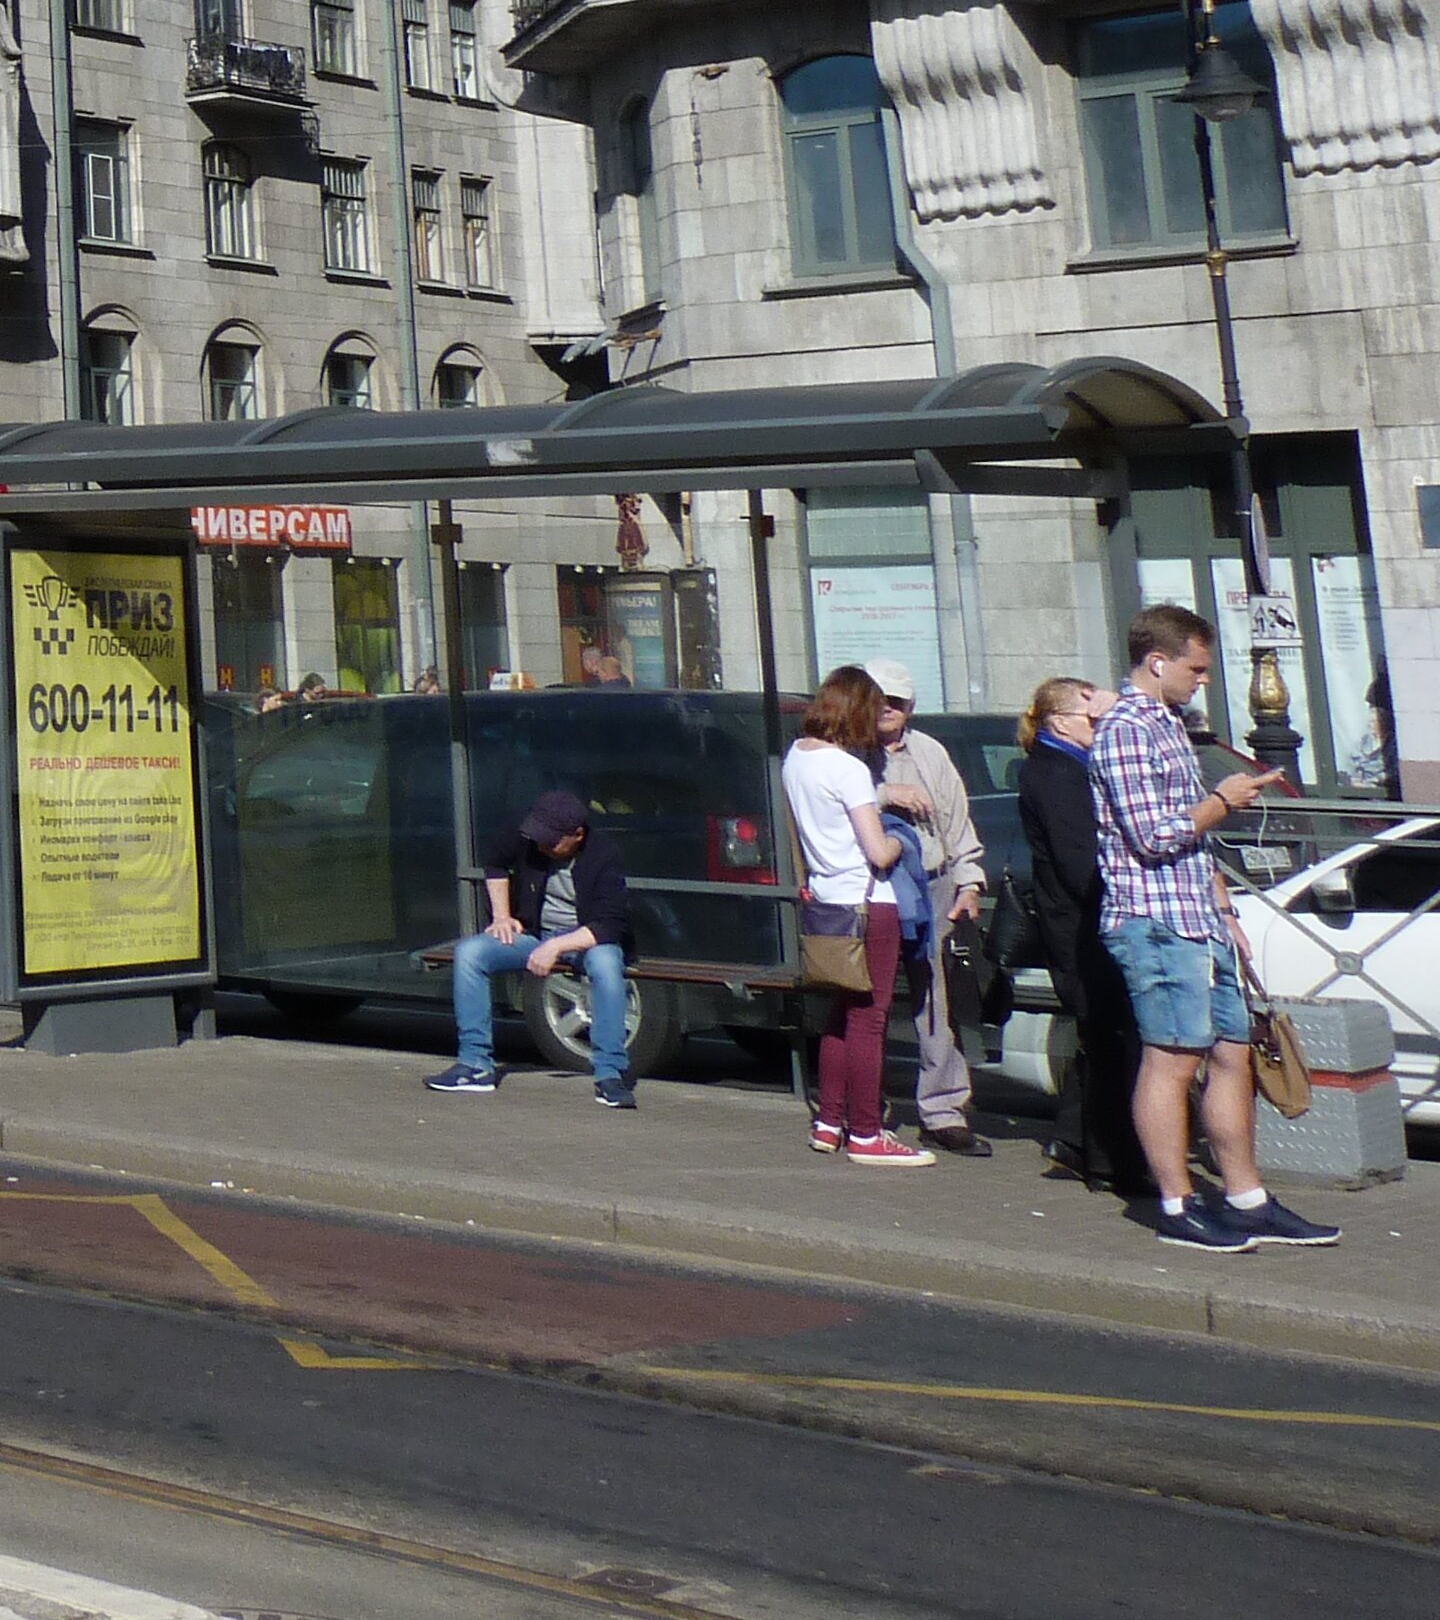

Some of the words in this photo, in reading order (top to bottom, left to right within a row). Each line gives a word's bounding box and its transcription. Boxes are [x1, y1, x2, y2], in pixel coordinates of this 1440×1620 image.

[191, 506, 349, 543] НИВЕРСАМ
[84, 589, 175, 632] ПРИЗ
[87, 634, 176, 660] ПОБЕЖДАЙ!
[28, 683, 179, 732] 600-11-11
[30, 757, 82, 770] РЕАЛЬНО
[86, 757, 139, 772] ДЕШЕВОЕ
[142, 756, 181, 770] ТАКСИ!
